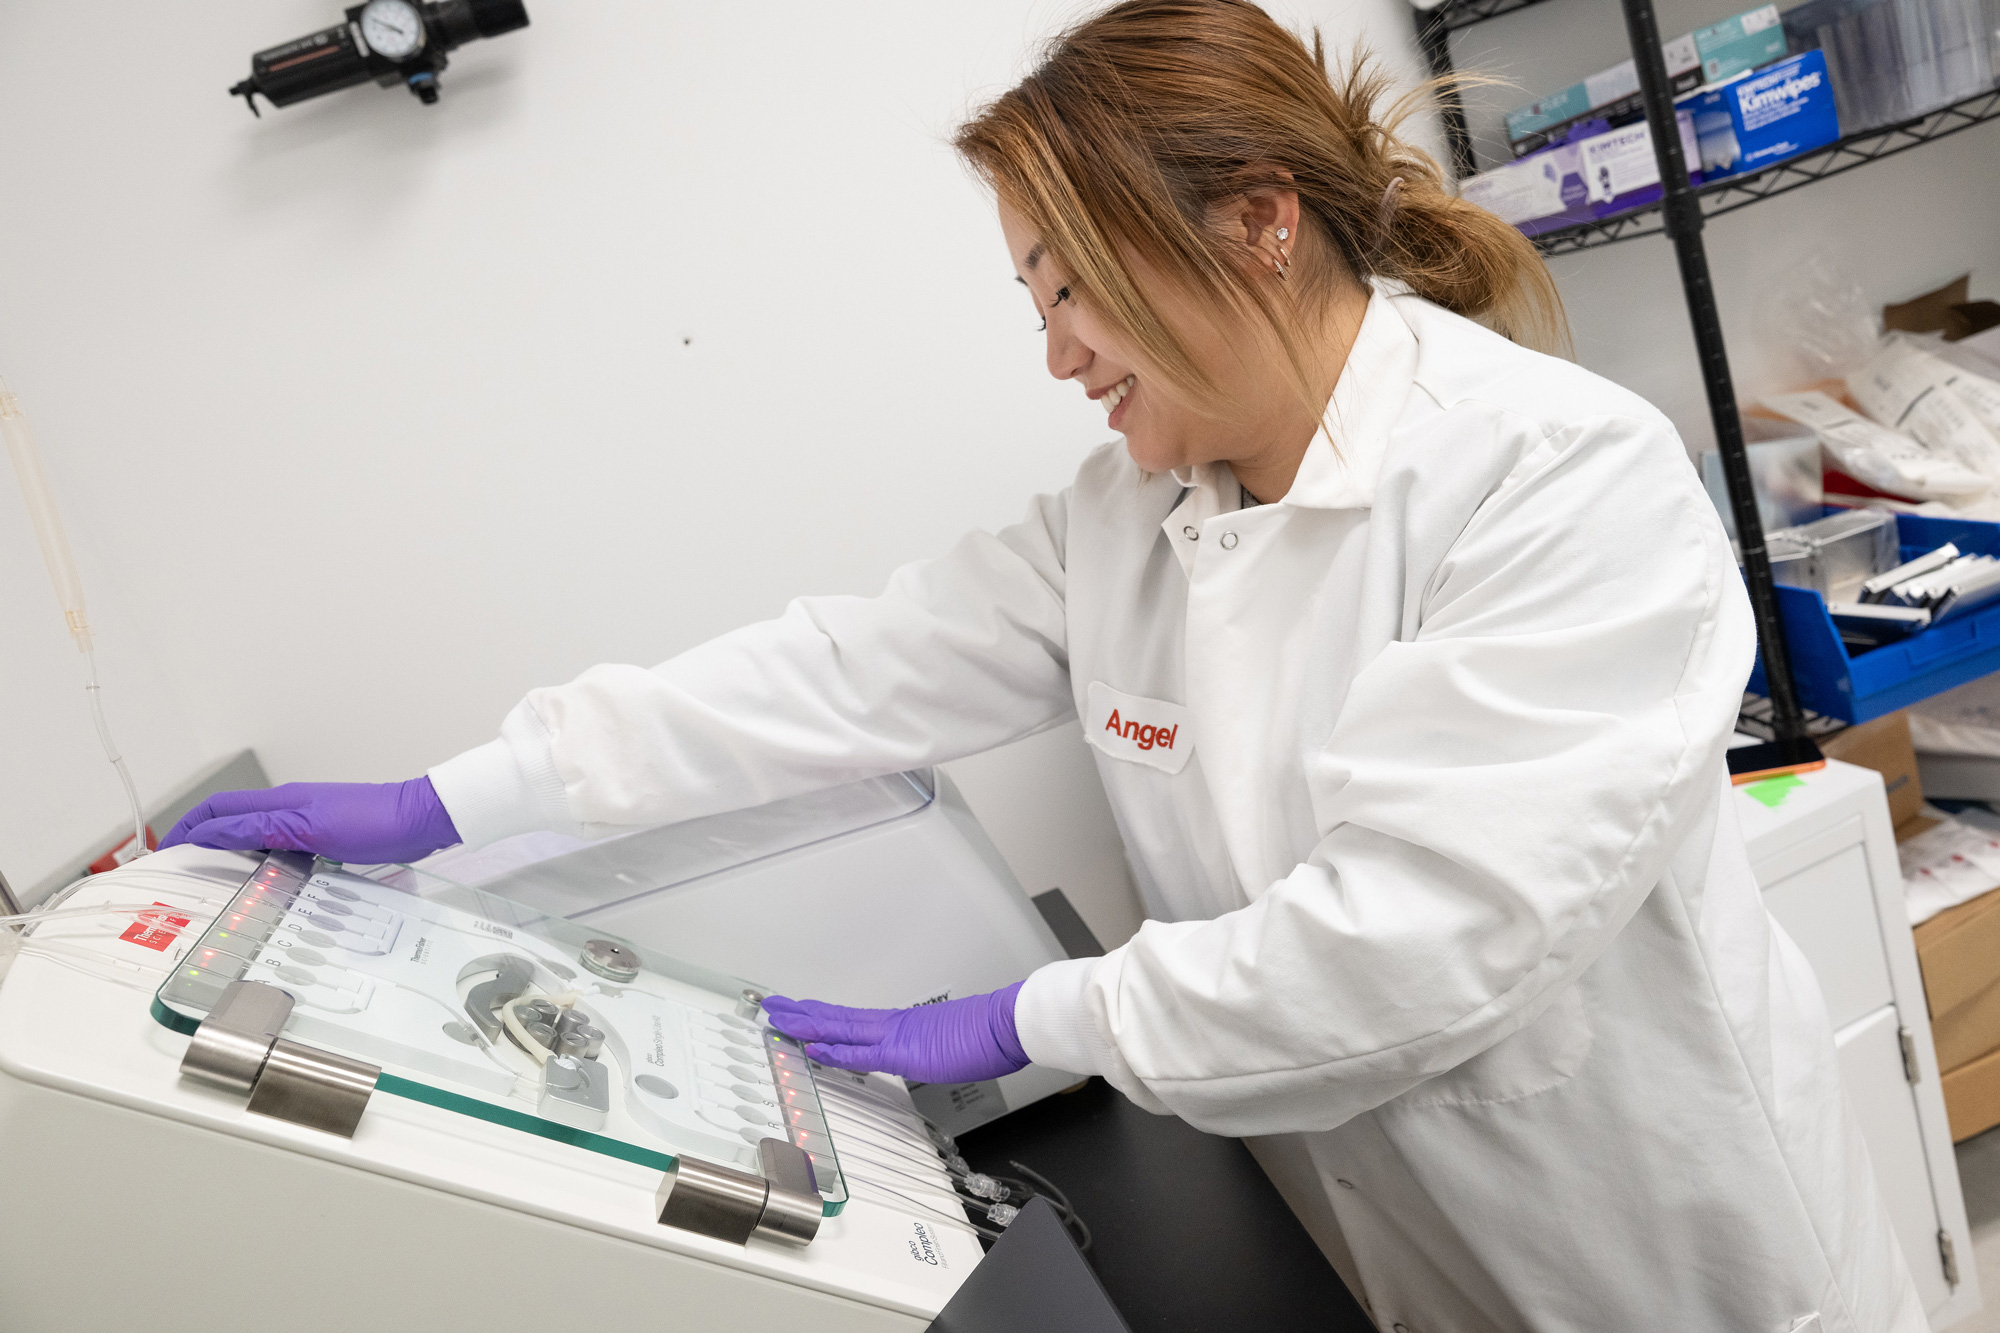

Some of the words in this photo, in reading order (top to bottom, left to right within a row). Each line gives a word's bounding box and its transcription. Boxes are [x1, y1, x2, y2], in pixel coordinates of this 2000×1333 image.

[1739, 72, 1822, 114] Kimwipes
[1105, 708, 1179, 751] Angel
[316, 879, 330, 887] G
[307, 893, 320, 901] F
[298, 908, 312, 916] E
[288, 923, 303, 932] D
[277, 940, 293, 948] C
[265, 958, 282, 967] B
[762, 1100, 775, 1108] S
[767, 1121, 780, 1130] R
[914, 1222, 938, 1265] Compleo
[908, 1240, 925, 1262] gibco
